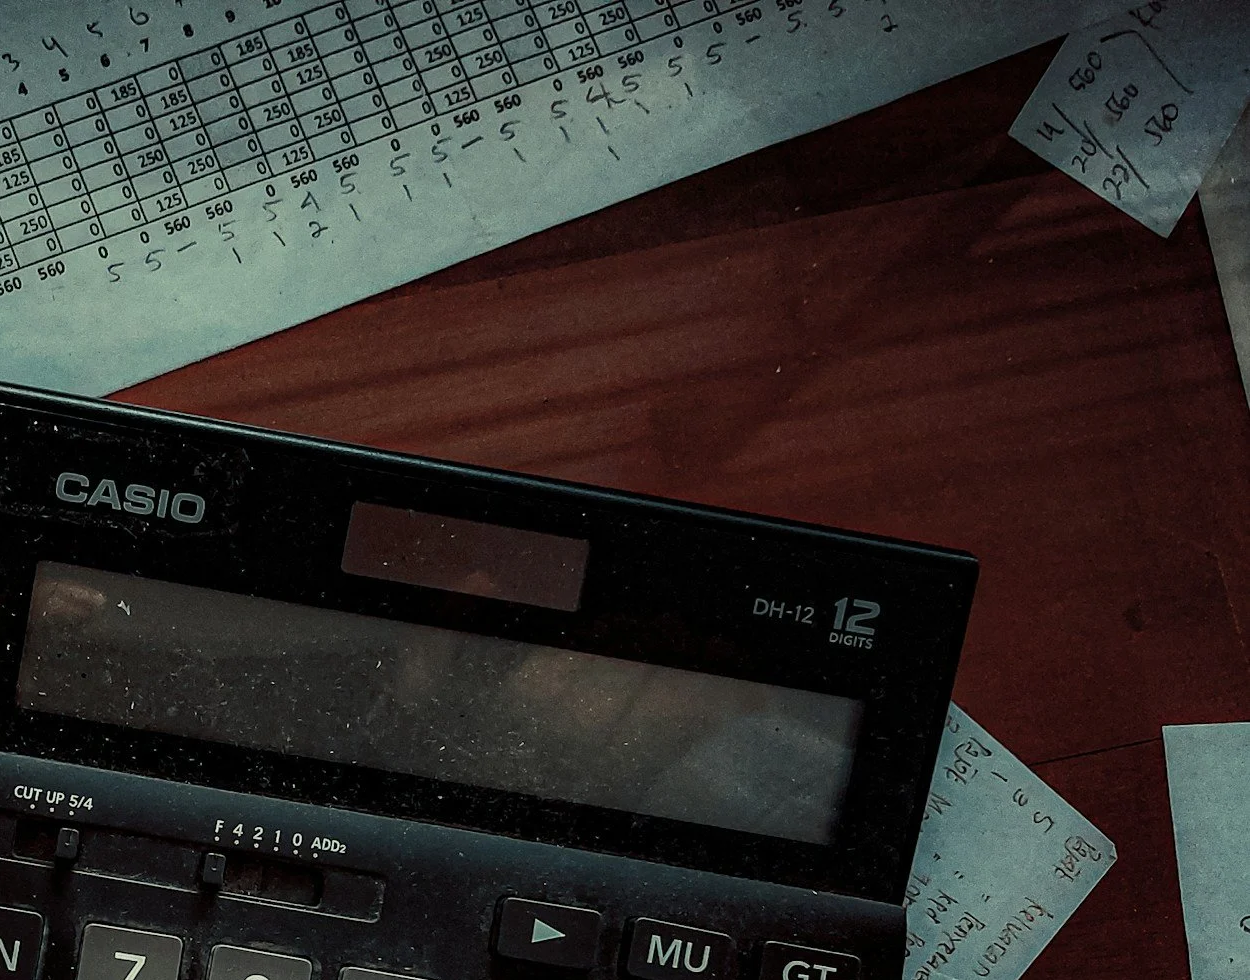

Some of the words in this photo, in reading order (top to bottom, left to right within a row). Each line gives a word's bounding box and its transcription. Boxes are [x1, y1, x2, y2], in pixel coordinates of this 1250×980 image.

[1068, 51, 1102, 91] 560
[55, 472, 206, 524] CASIO
[752, 598, 815, 624] DH-12
[830, 597, 881, 636] 12
[829, 630, 875, 650] DIGITS
[14, 785, 43, 801] CUT
[46, 790, 65, 805] UP
[68, 794, 93, 811] 5/4
[215, 819, 225, 833] F
[232, 823, 244, 837] 4
[252, 826, 264, 840] 2
[275, 830, 281, 844] 1
[292, 833, 303, 847] 0
[646, 934, 711, 973] MU
